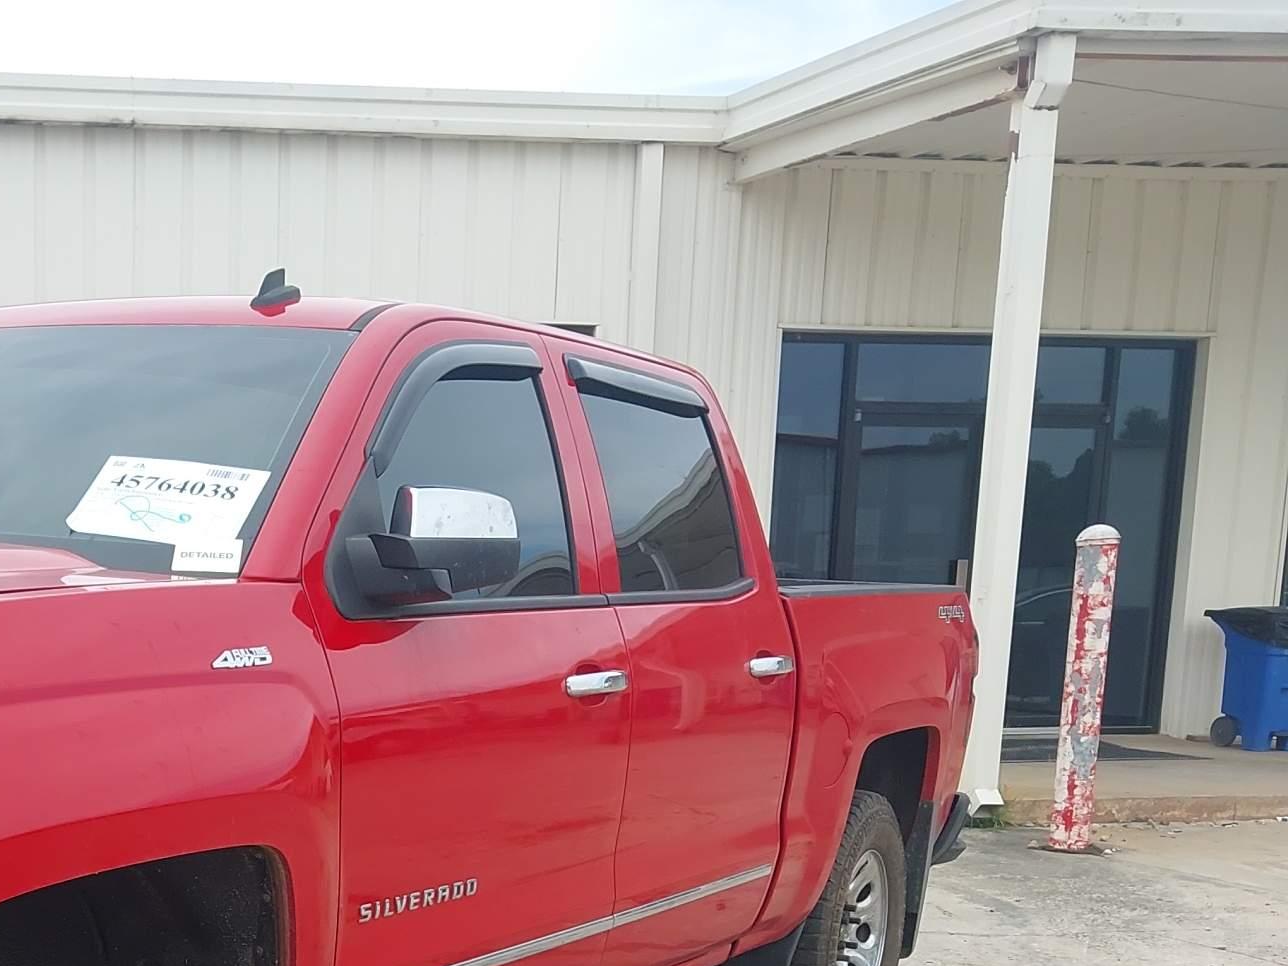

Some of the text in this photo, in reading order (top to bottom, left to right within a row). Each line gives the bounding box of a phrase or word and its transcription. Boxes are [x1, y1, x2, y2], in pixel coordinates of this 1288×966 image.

[110, 473, 240, 501] 45764038
[180, 551, 234, 560] DETAILED
[358, 878, 479, 923] SILVERADO
